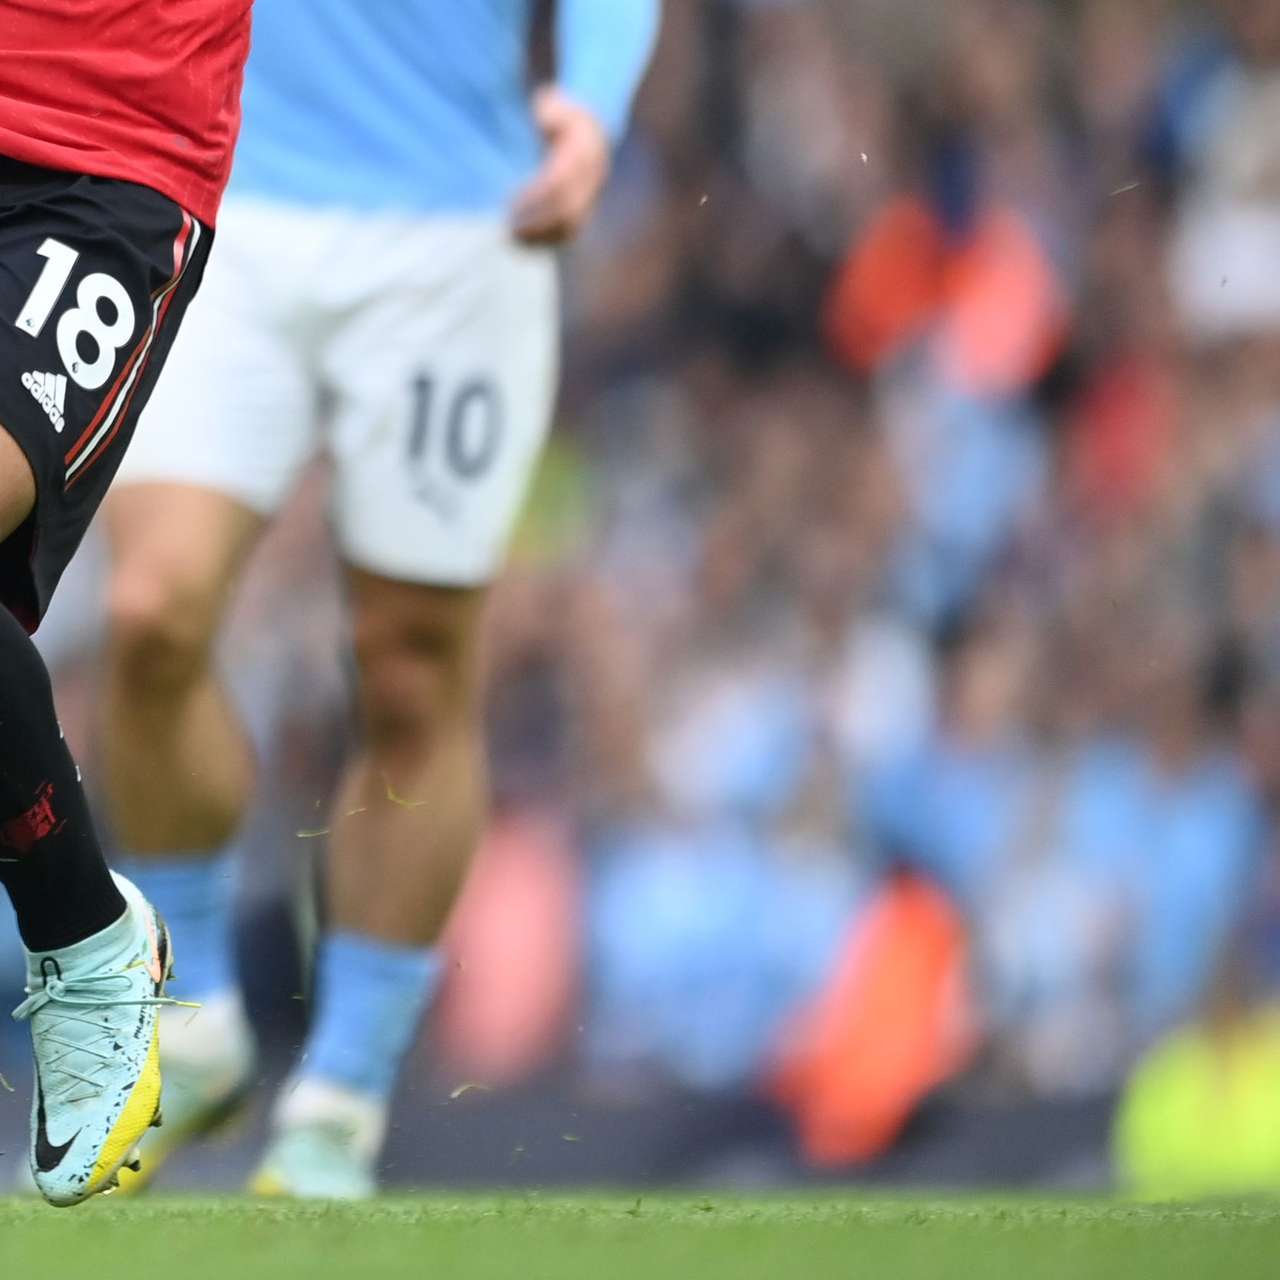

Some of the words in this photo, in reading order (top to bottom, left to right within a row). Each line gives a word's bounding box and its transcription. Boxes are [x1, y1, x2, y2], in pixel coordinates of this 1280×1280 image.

[15, 237, 135, 390] 18
[21, 372, 65, 433] adidas
[407, 370, 503, 484] 10
